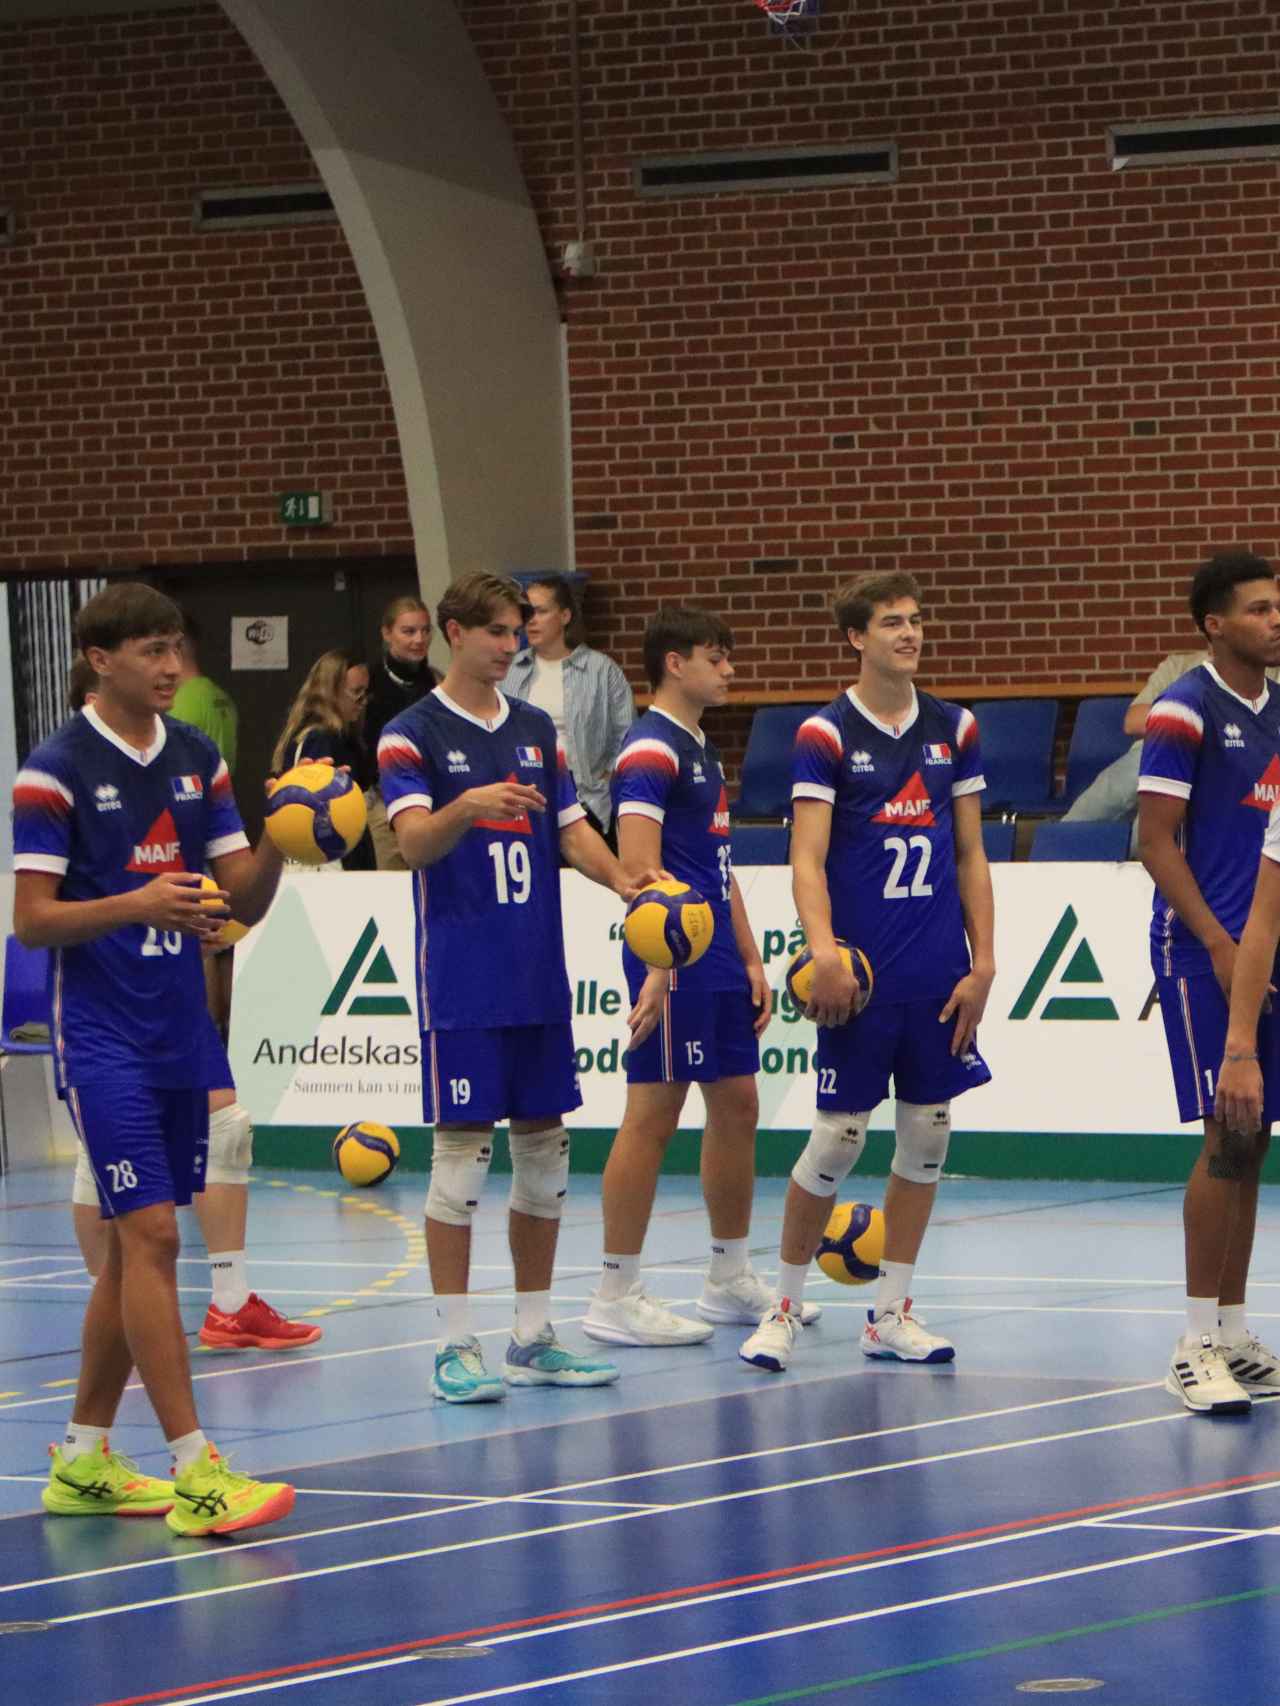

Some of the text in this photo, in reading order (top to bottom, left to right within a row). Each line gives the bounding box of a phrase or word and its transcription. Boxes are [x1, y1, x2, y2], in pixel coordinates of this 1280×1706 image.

[1254, 783, 1280, 802] MAI
[884, 800, 931, 818] MAIF
[133, 842, 181, 865] MAIF
[883, 834, 934, 900] 22
[488, 841, 532, 904] 19
[253, 1036, 421, 1065] Andelskas
[685, 1041, 704, 1065] 15
[293, 1079, 353, 1094] Sammen
[357, 1077, 383, 1094] kan
[450, 1078, 471, 1105] 19
[819, 1067, 837, 1094] 22
[105, 1159, 138, 1193] 28
